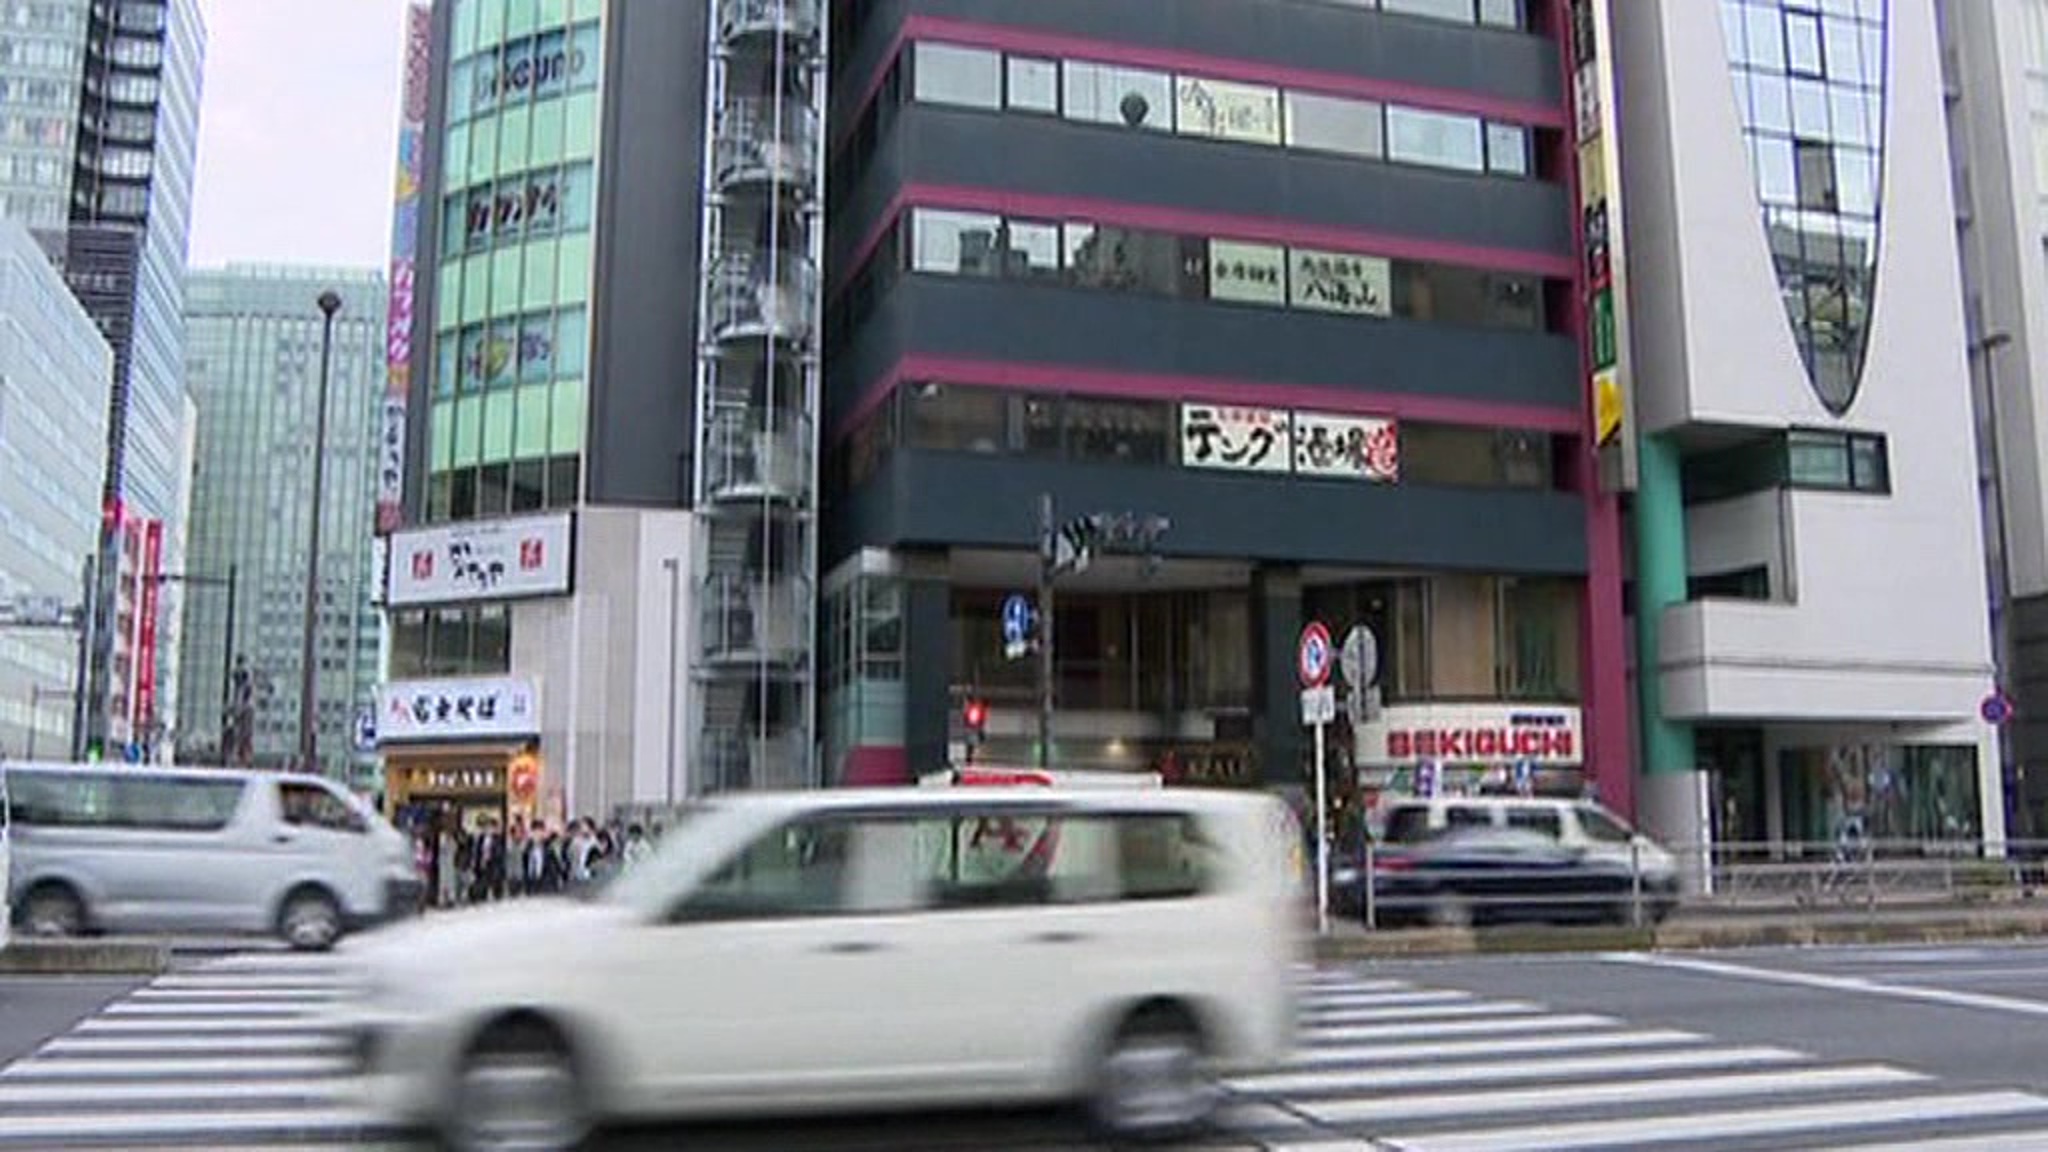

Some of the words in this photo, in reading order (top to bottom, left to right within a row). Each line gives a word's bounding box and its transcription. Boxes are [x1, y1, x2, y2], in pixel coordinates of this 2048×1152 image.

[1304, 279, 1378, 306] 八海山
[1387, 729, 1573, 757] SEKIGUCHI
